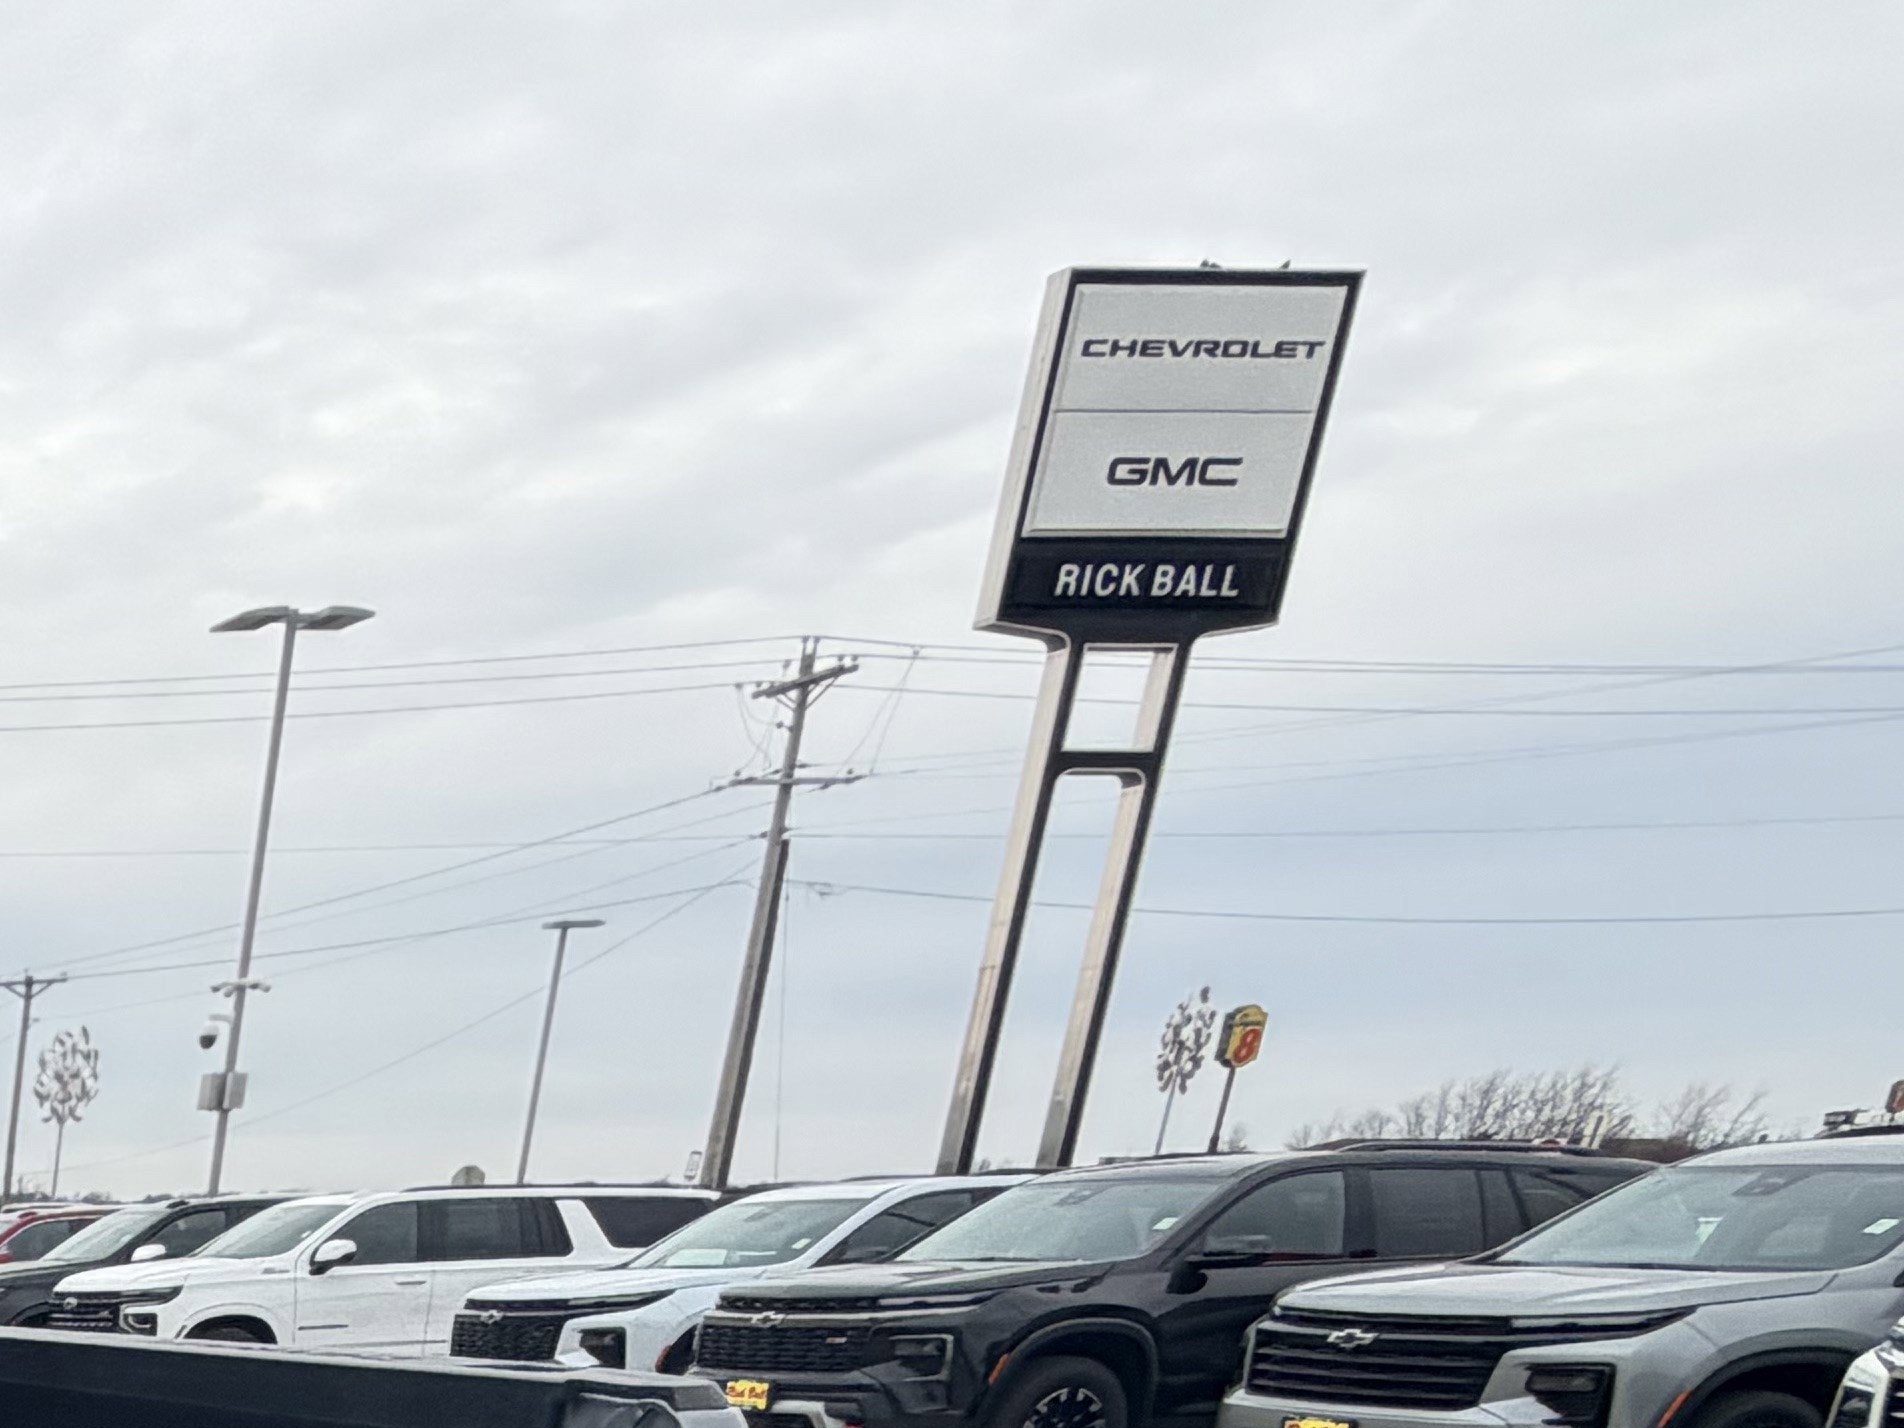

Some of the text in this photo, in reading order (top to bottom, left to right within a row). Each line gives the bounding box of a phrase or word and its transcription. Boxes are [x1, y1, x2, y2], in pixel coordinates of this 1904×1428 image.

[1081, 339, 1326, 360] CHEVROLET
[1106, 457, 1243, 486] GMC
[1054, 564, 1240, 598] RICK BALL
[1233, 1029, 1262, 1064] 8
